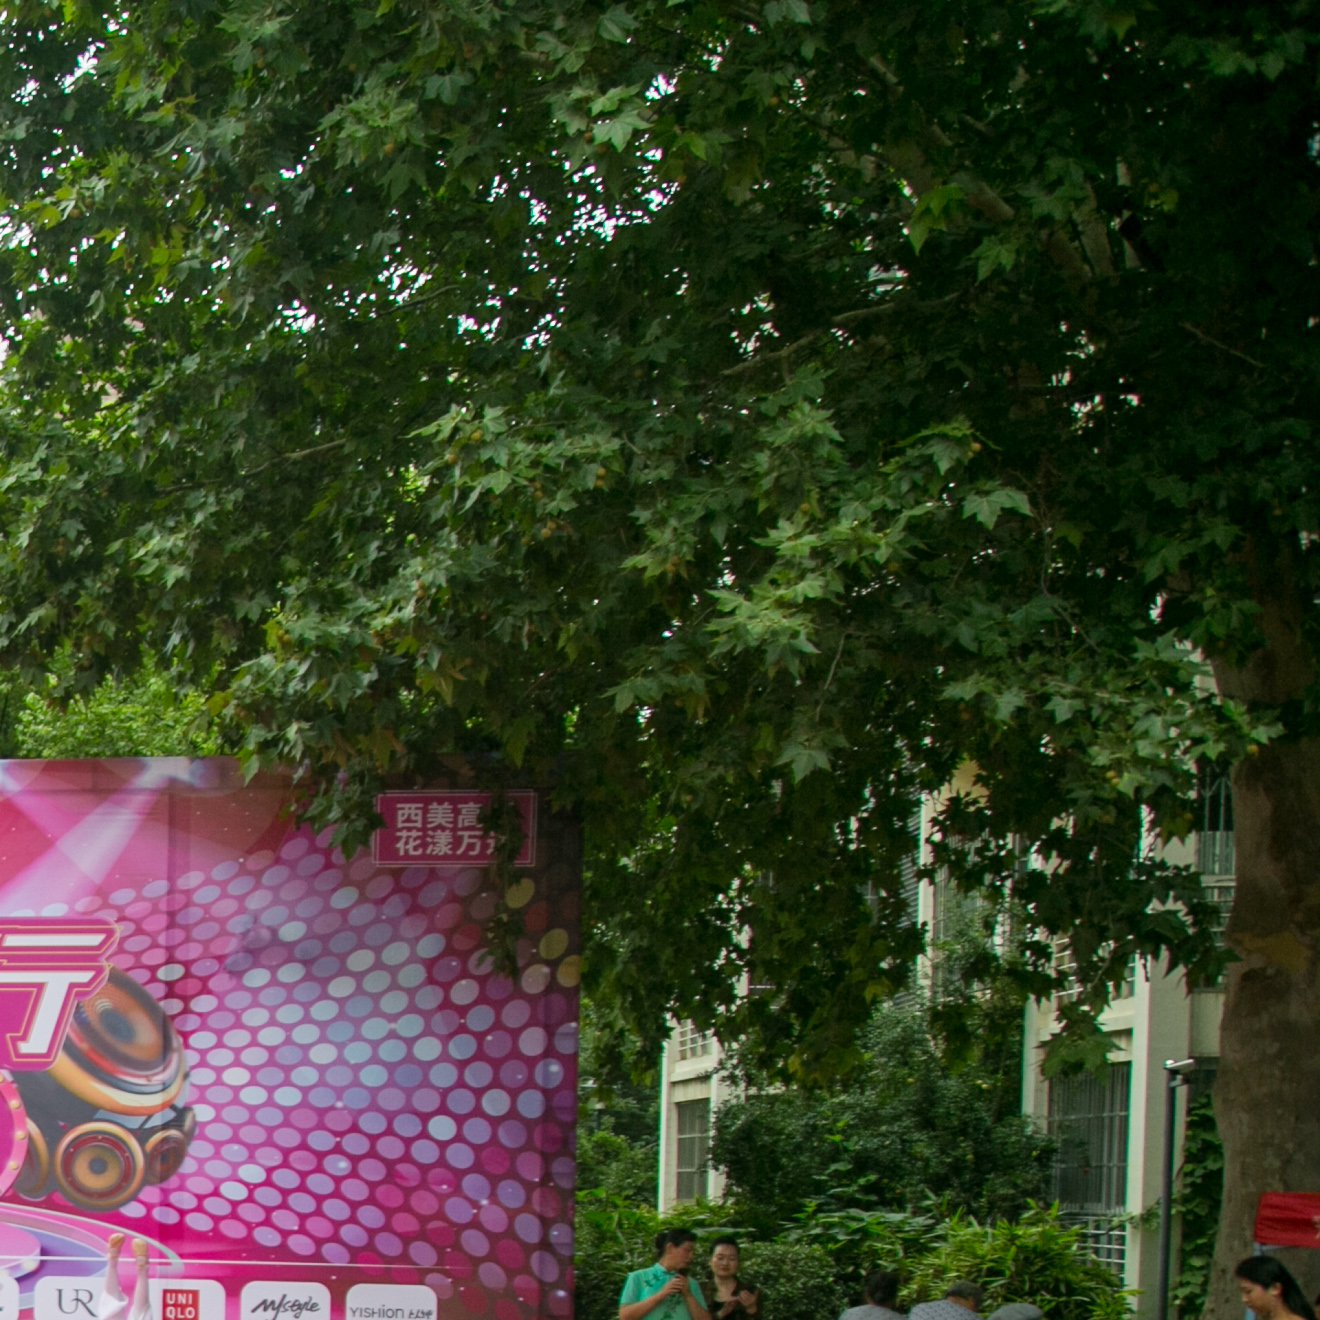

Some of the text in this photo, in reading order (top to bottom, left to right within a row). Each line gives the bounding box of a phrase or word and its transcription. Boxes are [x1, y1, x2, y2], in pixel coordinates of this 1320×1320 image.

[56, 1288, 98, 1318] UR
[166, 1292, 194, 1304] UNI
[165, 1306, 197, 1320] QLO
